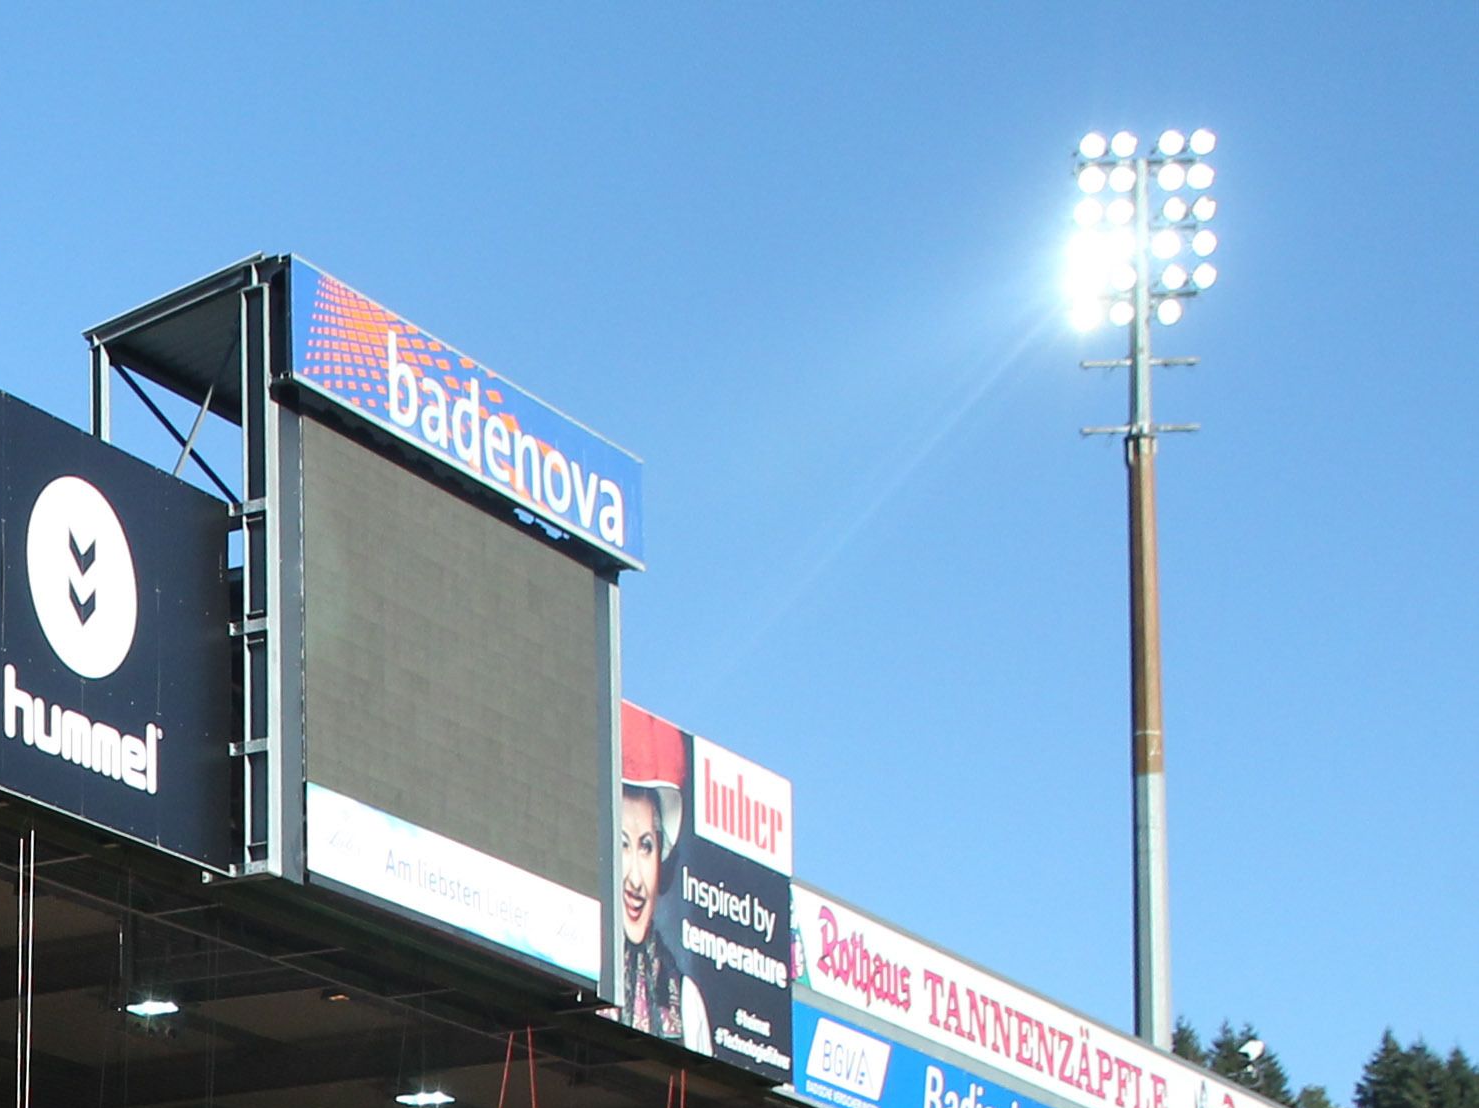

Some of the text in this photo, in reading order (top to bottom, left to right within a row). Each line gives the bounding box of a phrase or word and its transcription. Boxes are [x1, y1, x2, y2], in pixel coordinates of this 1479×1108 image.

[388, 330, 623, 548] badenova
[4, 663, 157, 795] hummel
[705, 757, 783, 855] huber
[385, 848, 413, 885] Am
[417, 858, 482, 912] liebsten
[682, 866, 776, 943] Inspired by
[682, 919, 788, 989] temperature
[817, 905, 912, 1013] Rothaus
